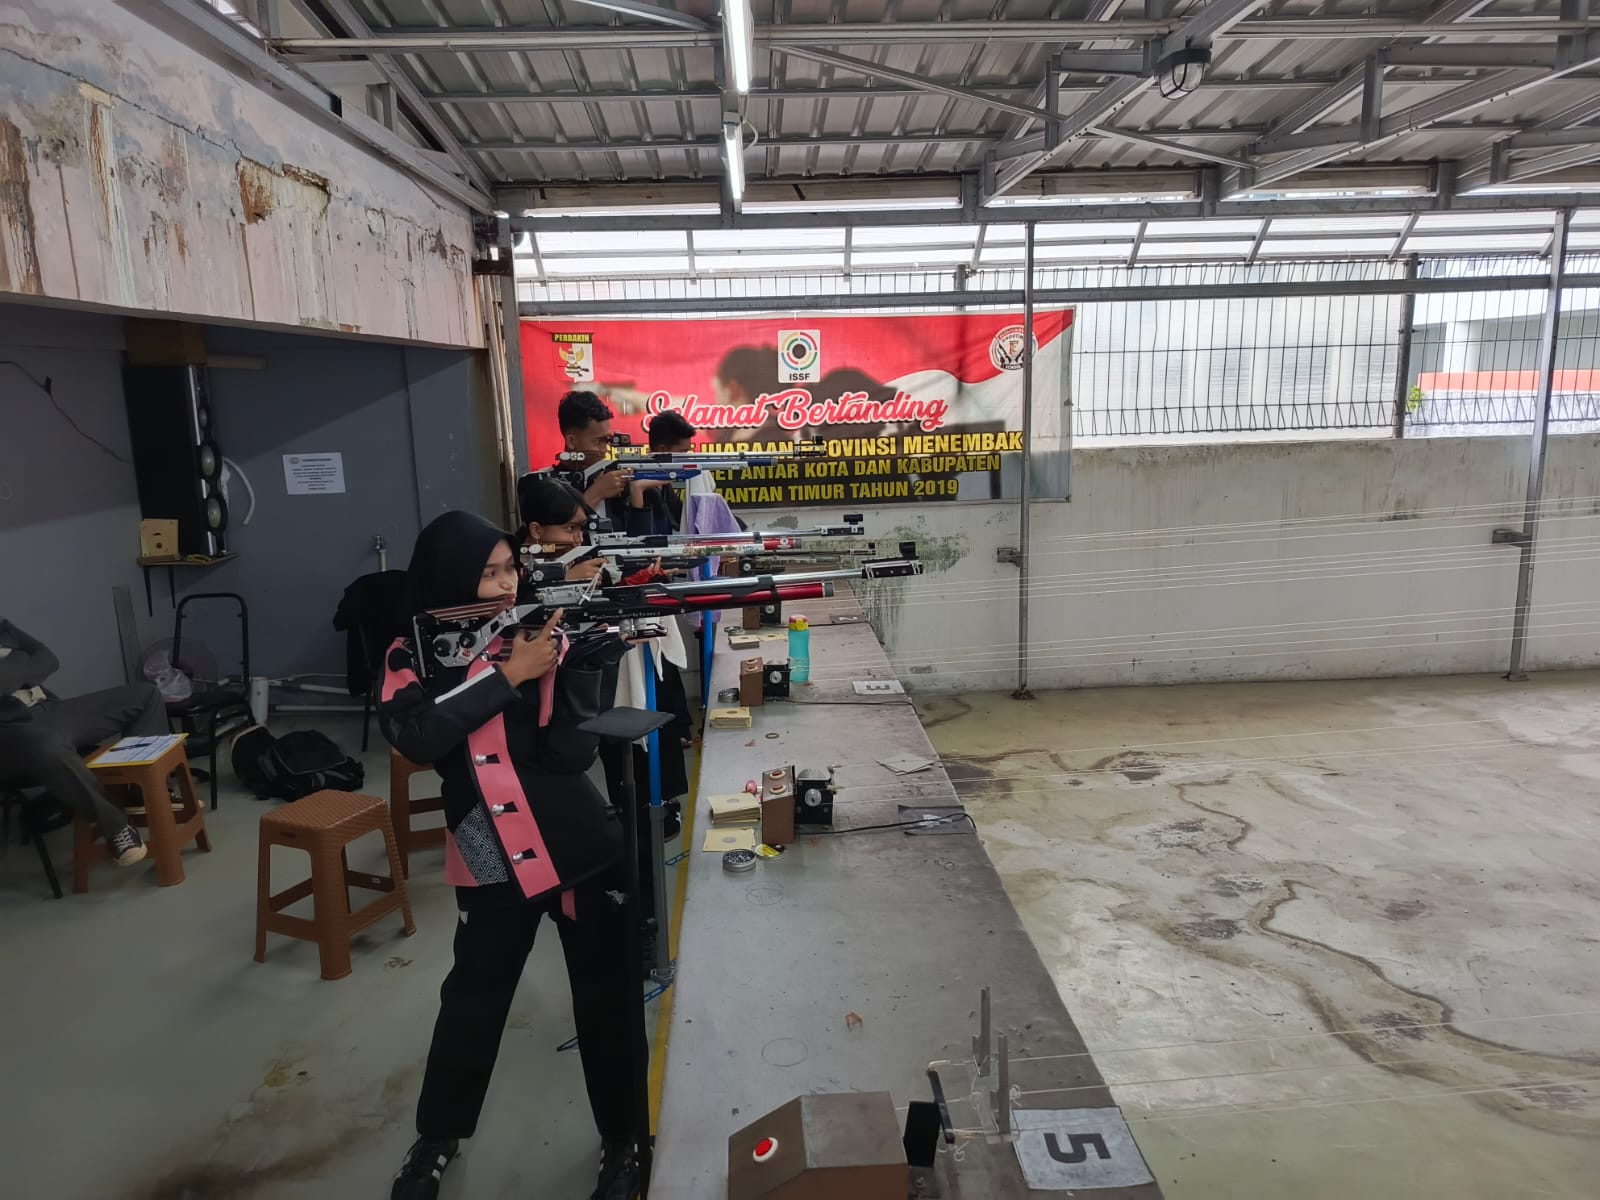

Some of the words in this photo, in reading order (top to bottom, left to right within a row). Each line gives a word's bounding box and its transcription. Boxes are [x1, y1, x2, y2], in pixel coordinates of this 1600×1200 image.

[788, 372, 811, 382] ISSF
[778, 389, 948, 431] Bertanding
[902, 431, 1024, 455] MENEMBAK
[741, 463, 799, 480] ANTAR
[804, 461, 849, 478] KOTA
[854, 459, 892, 476] DAN
[896, 455, 1001, 475] KABUPATEN
[790, 483, 845, 501] TIMUR
[849, 481, 909, 498] TAHUN
[913, 479, 960, 496] 2019
[1043, 1132, 1112, 1164] 5
